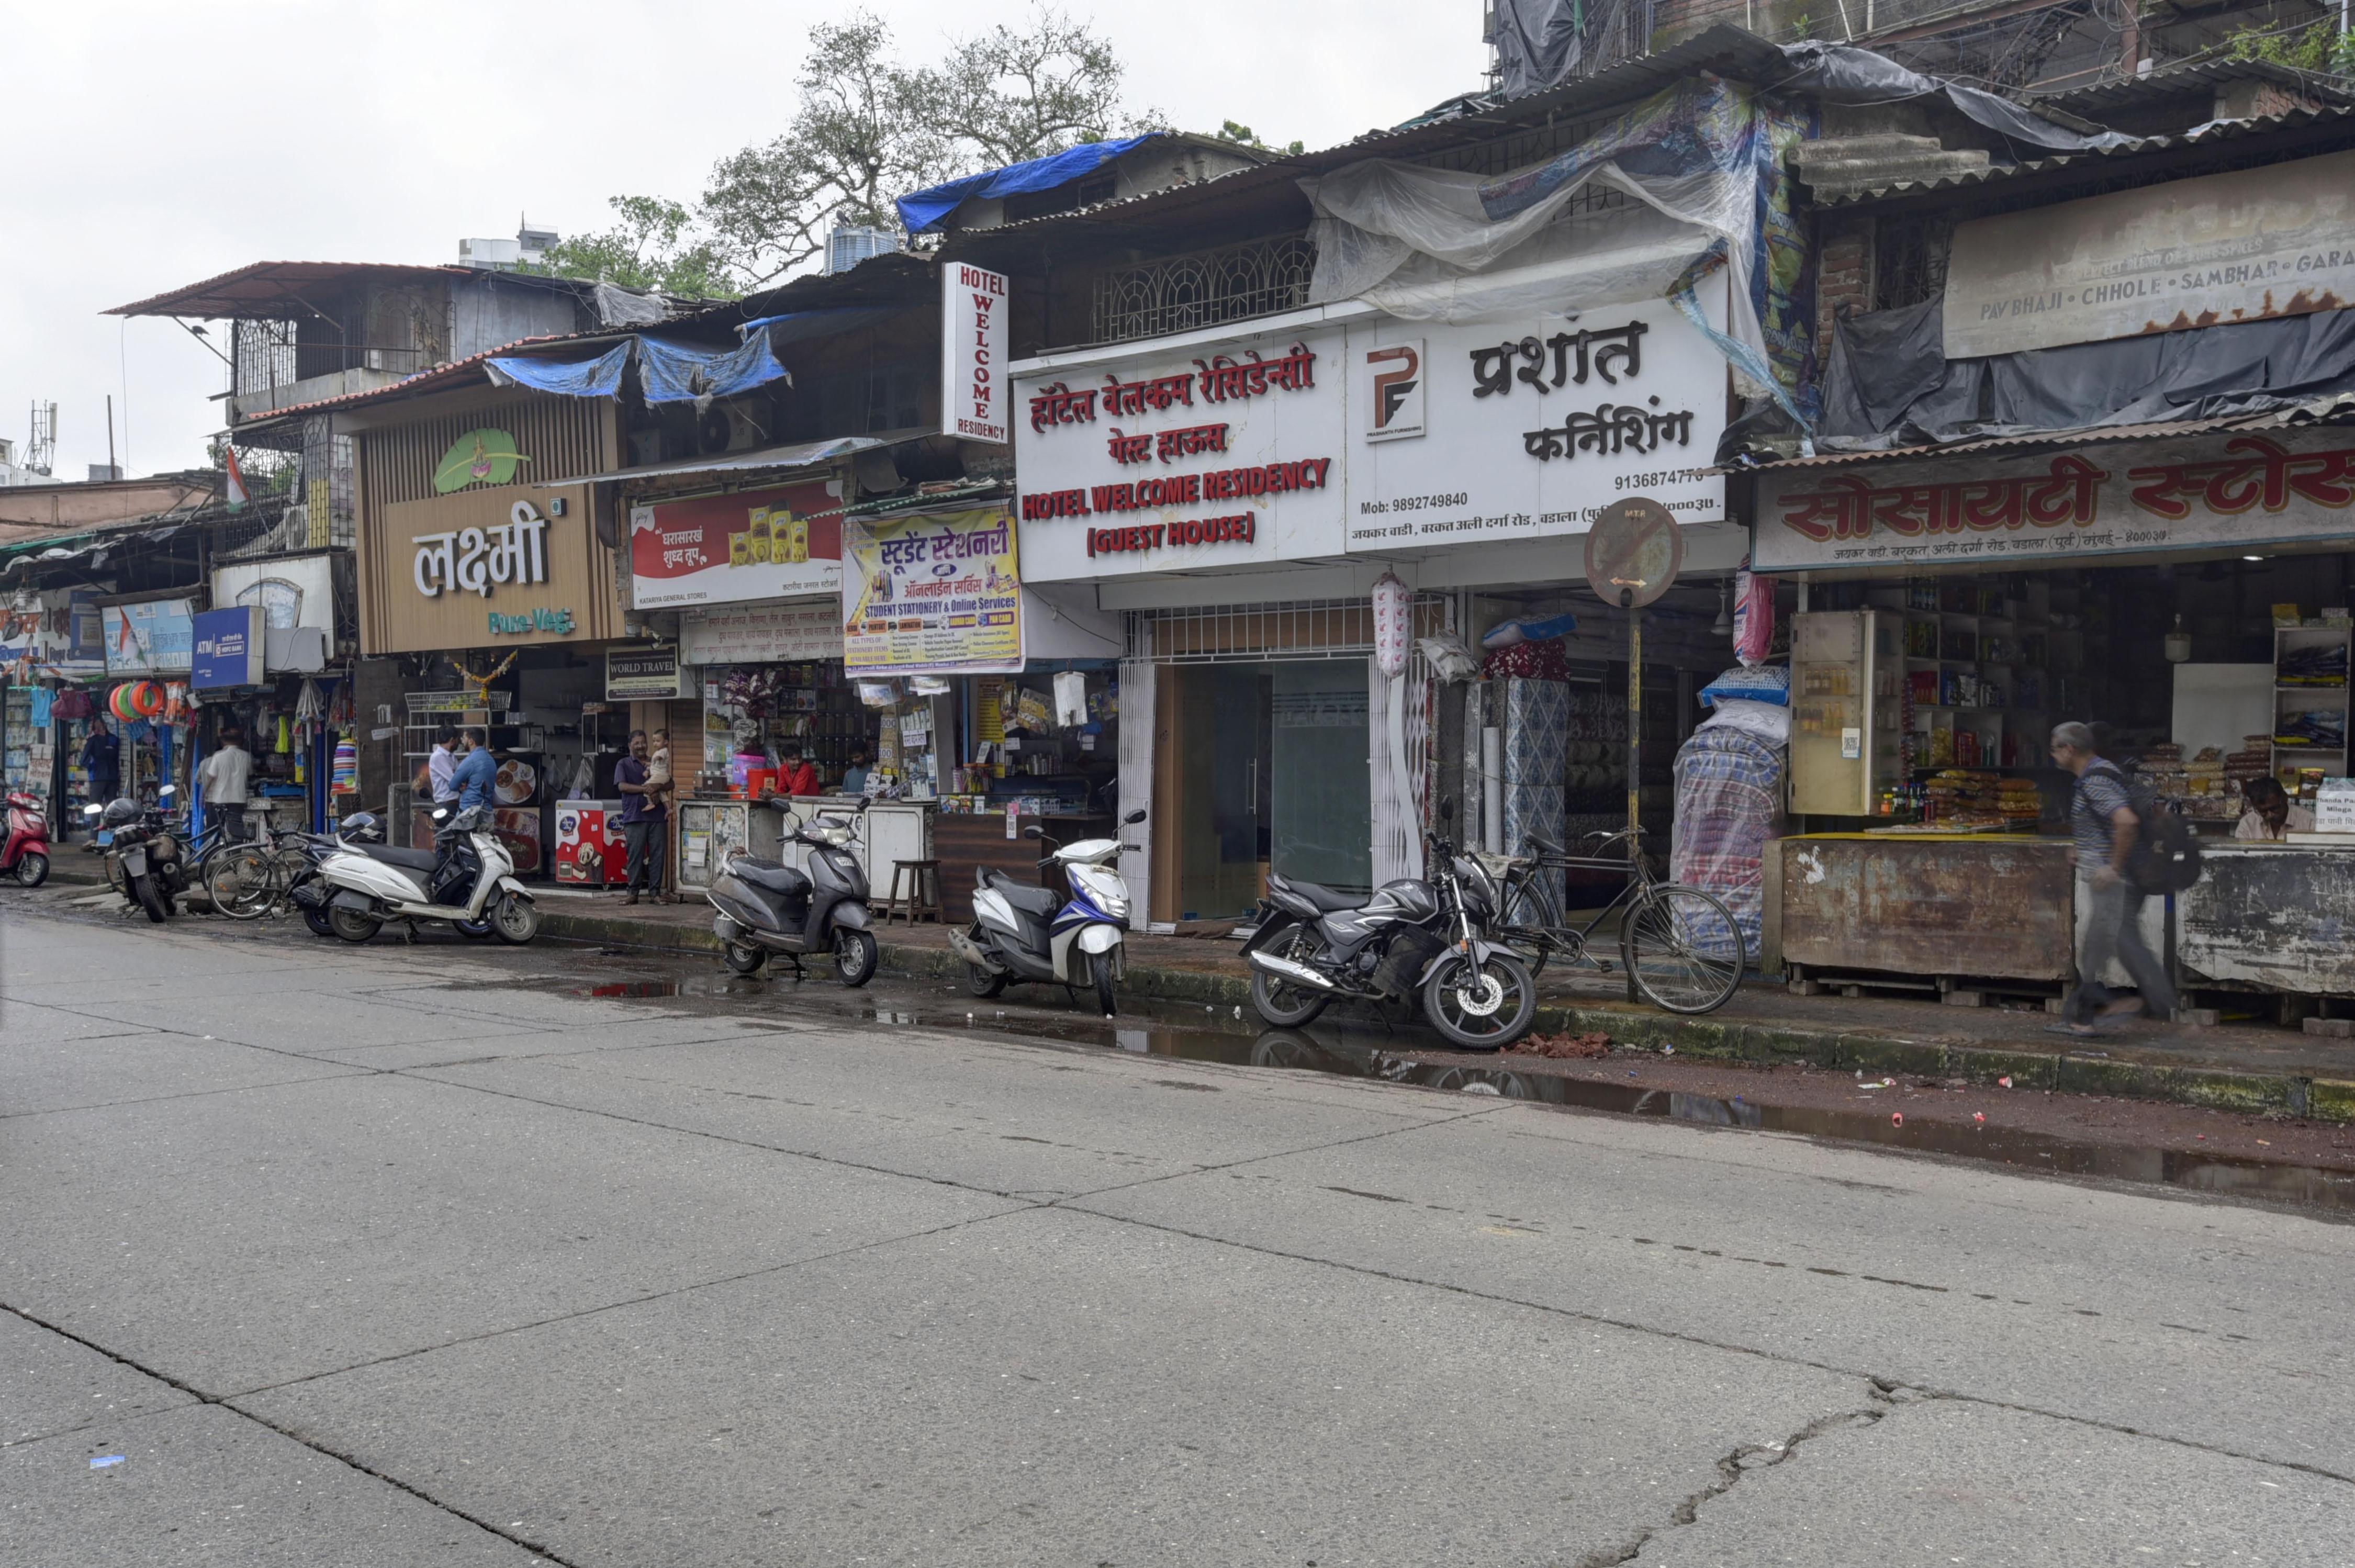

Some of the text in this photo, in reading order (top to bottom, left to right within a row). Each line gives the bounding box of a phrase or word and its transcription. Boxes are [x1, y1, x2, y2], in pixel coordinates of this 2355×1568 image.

[1980, 299, 2009, 321] PAV
[2012, 292, 2062, 317] BHAJI
[2081, 277, 2160, 305] CHHOLE
[2181, 260, 2278, 290] SAMBHAR
[958, 265, 1005, 440] HOTEL WELCOME RESIDENCY
[1029, 382, 1097, 433] हॉटेल
[1102, 374, 1195, 416] वेलकम
[1107, 422, 1229, 464] गेस्ट हाऊस
[1367, 425, 1422, 438] PRASHANTH FURNISHING
[1022, 488, 1091, 521] HOTEL
[1092, 474, 1200, 512] WELCOME
[1203, 458, 1331, 500] RESIDENCY
[1777, 454, 2112, 542] सोसायटी
[1361, 492, 1467, 514] Mob: 9892749840
[663, 525, 703, 545] घरासारखं
[1087, 511, 1255, 557] (GUEST HOUSE)
[1352, 527, 1386, 540] जयकर
[1456, 517, 1482, 530] अली
[1486, 513, 1509, 528] दर्गा
[1540, 511, 1577, 524] वडाला
[412, 500, 547, 598] लक्ष्मी
[685, 547, 699, 566] तूप
[879, 531, 927, 575] स्टूडेंट
[1834, 548, 1865, 559] जयकर
[1933, 541, 1957, 555] अली
[904, 580, 951, 598] ऑनलाईन
[865, 597, 1016, 618] STUDENT STATIONERY & Online Services
[488, 612, 533, 634] Pure
[197, 640, 212, 654] ATM
[610, 661, 675, 674] WORLD TRAVEL
